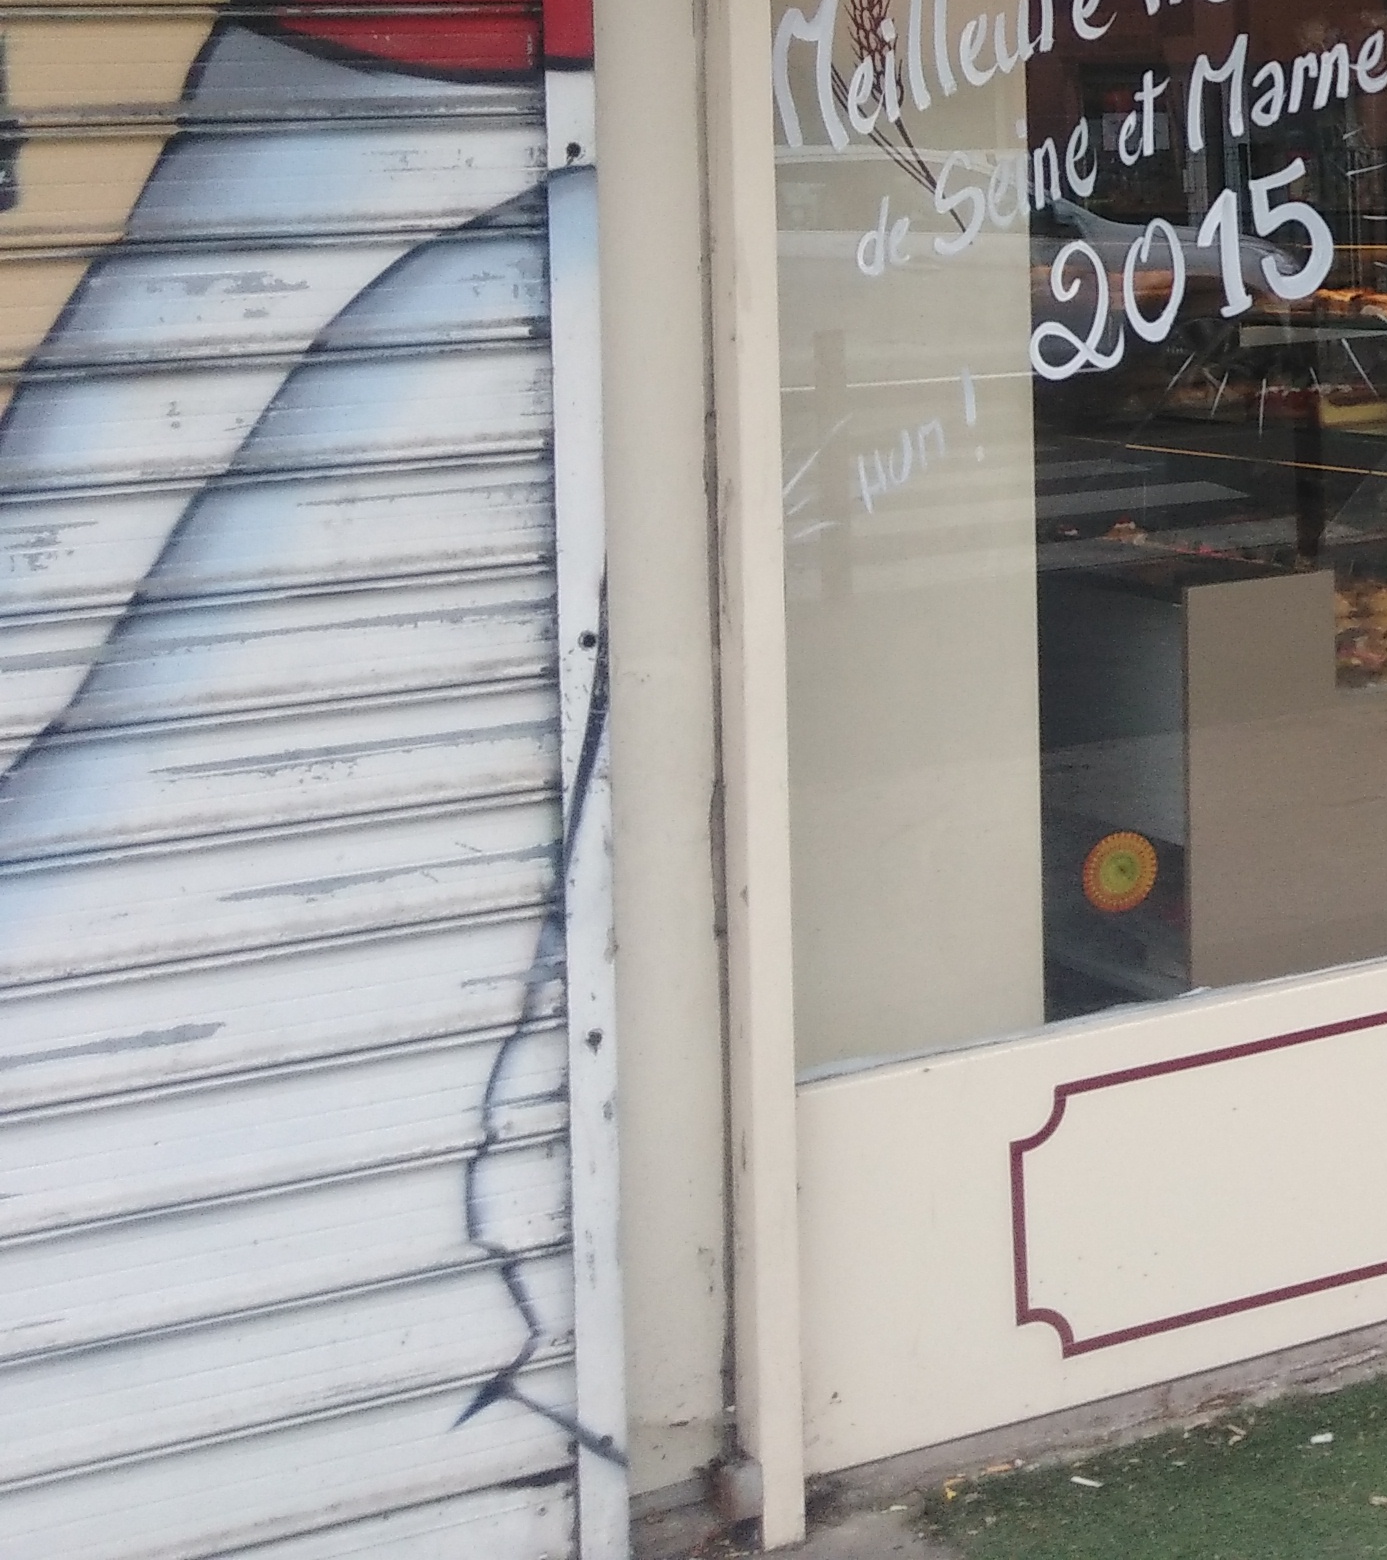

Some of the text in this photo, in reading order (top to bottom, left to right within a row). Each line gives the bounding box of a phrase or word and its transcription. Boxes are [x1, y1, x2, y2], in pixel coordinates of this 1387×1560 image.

[856, 195, 912, 276] de
[933, 116, 1097, 255] Seine
[1118, 68, 1170, 167] et
[1029, 157, 1334, 380] 2015
